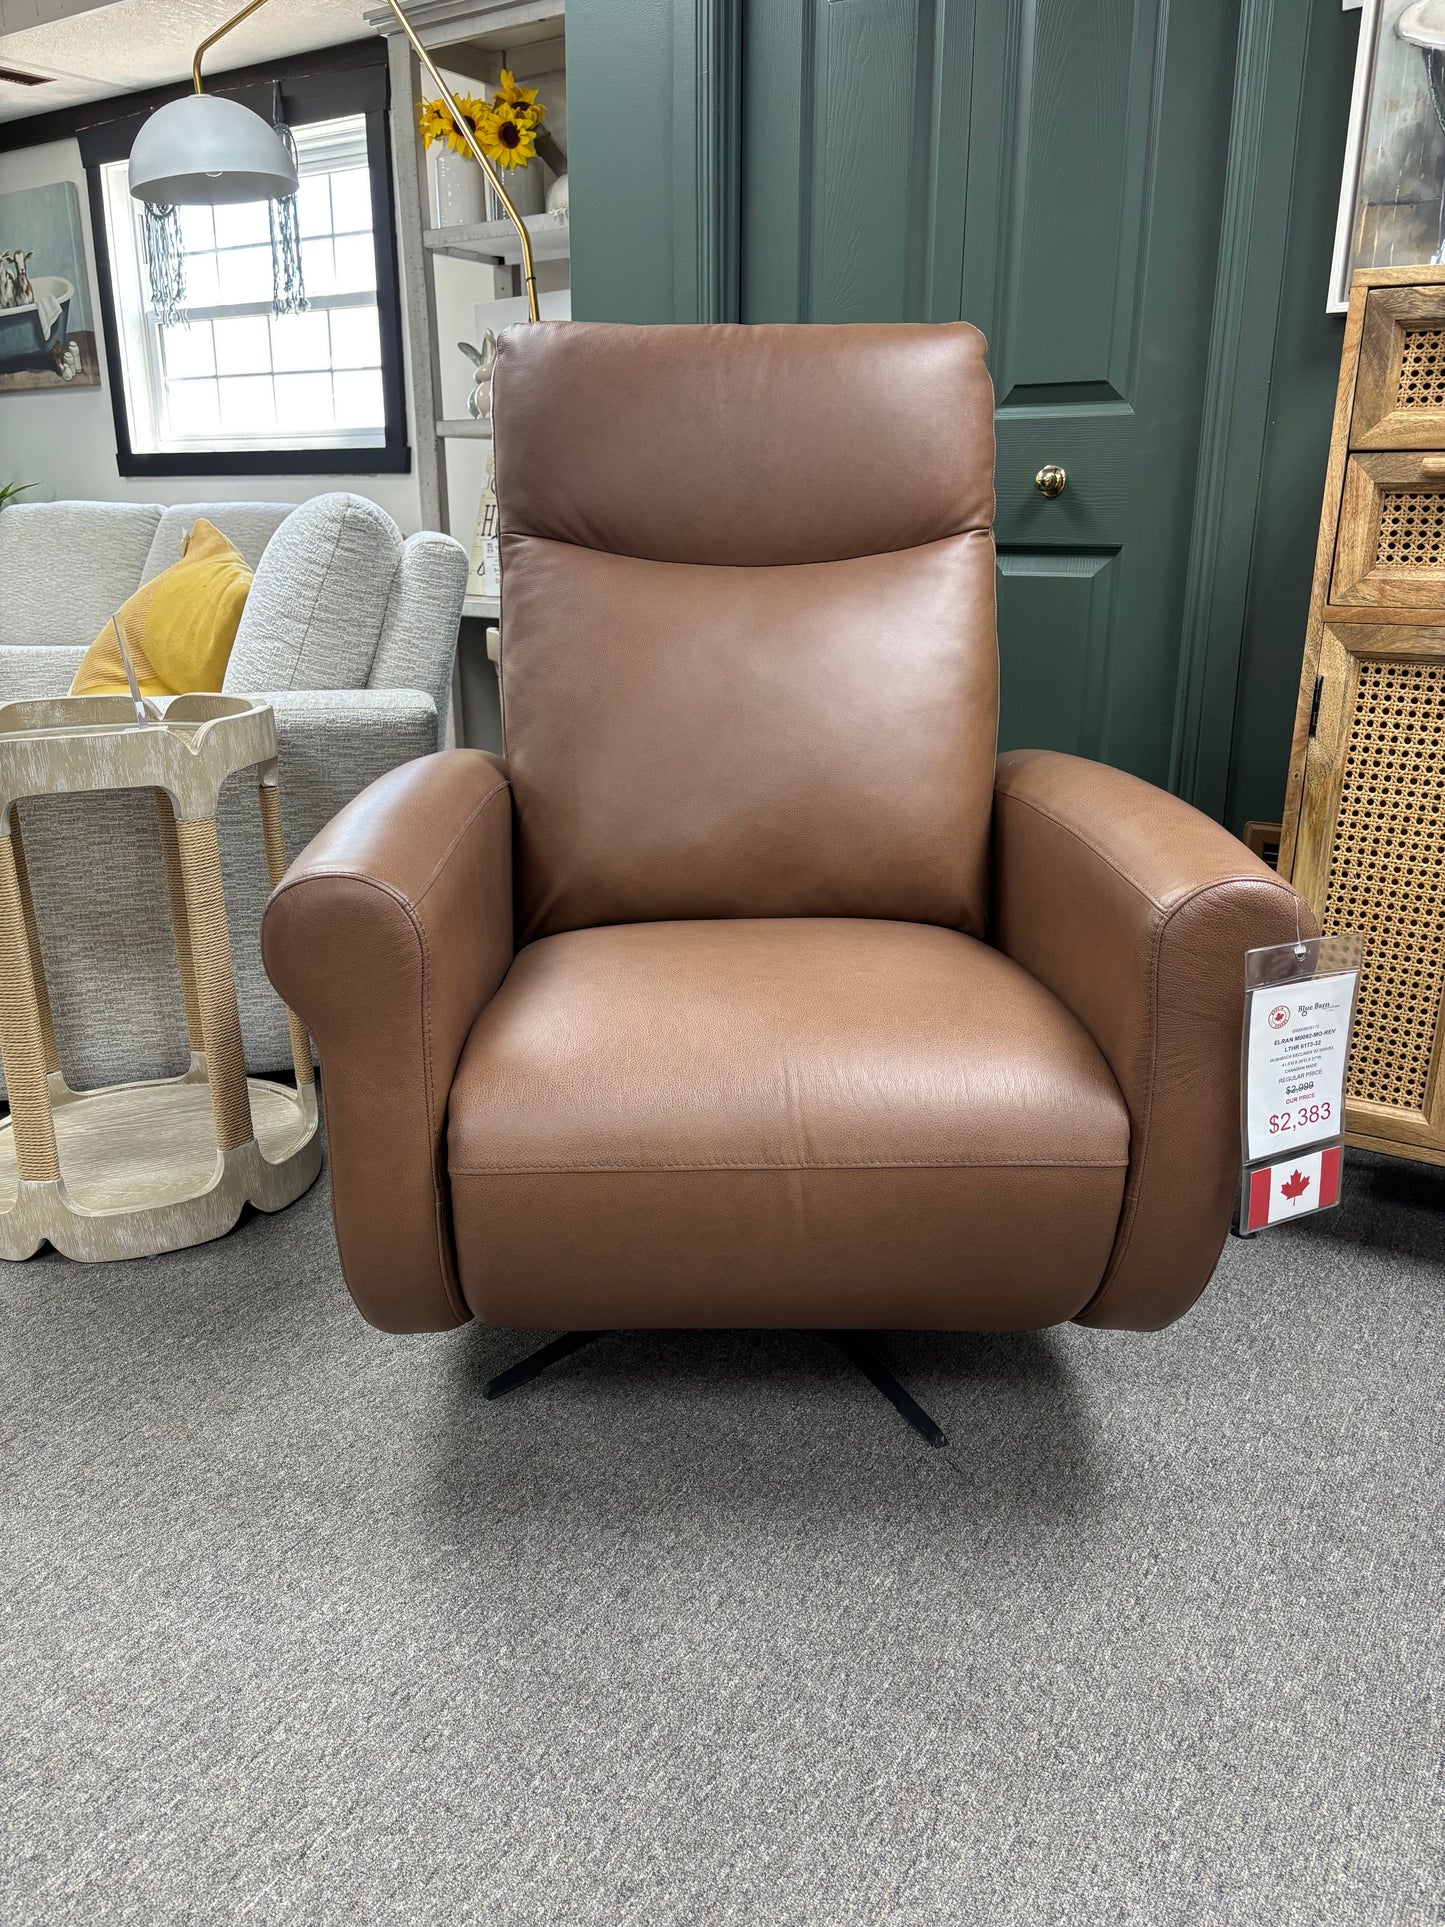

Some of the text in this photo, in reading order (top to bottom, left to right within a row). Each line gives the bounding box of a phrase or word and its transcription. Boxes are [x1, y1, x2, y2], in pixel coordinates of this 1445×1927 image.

[1298, 1004, 1313, 1017] Blue
[1314, 1002, 1330, 1010] Barn
[1274, 1036, 1294, 1046] ELRAN
[1284, 1040, 1322, 1053] LTHR 6173-32
[1278, 1068, 1323, 1083] REGULAR PRICE
[1285, 1080, 1314, 1095] $2,999
[1285, 1092, 1315, 1105] OUR PRICE
[1269, 1102, 1331, 1134] $2,383
